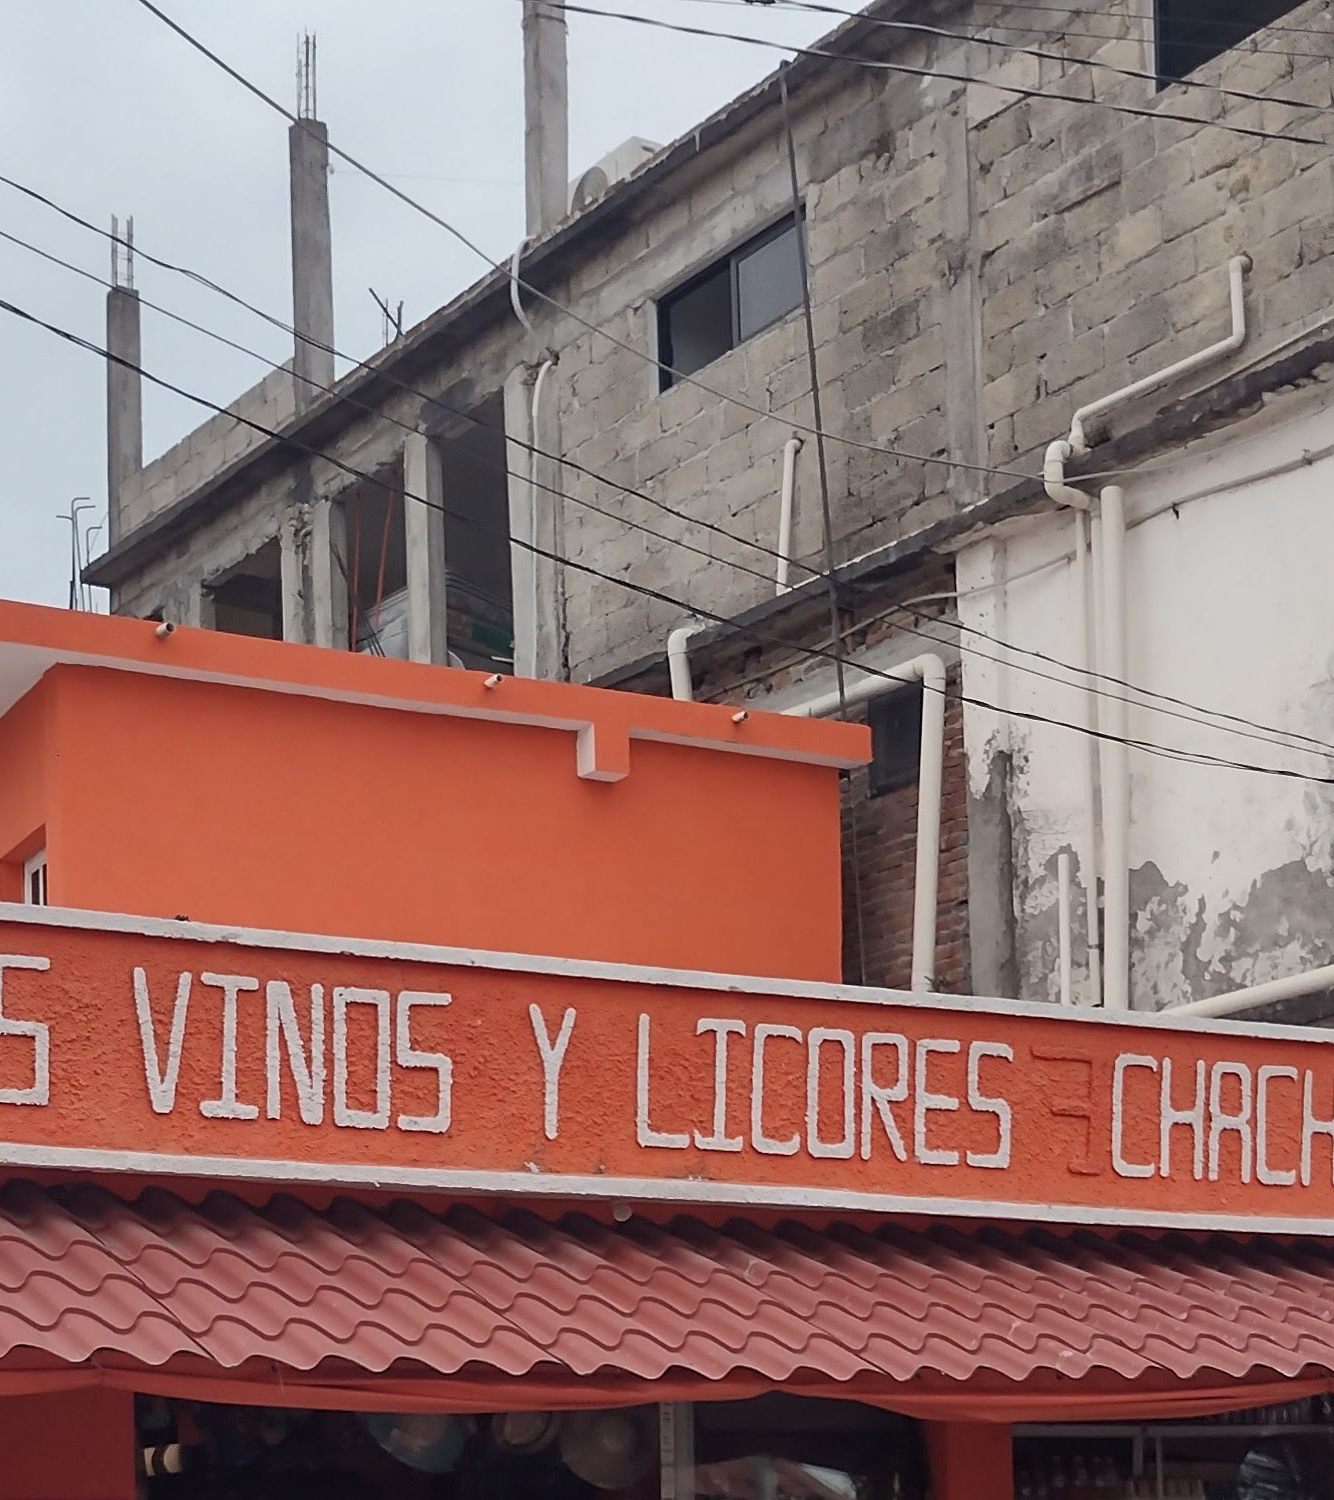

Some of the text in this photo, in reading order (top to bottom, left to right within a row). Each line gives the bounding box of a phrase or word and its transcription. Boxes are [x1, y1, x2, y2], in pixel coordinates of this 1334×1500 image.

[133, 966, 454, 1134] VINOS
[529, 1003, 577, 1140] Y
[635, 1012, 1014, 1169] LICORES
